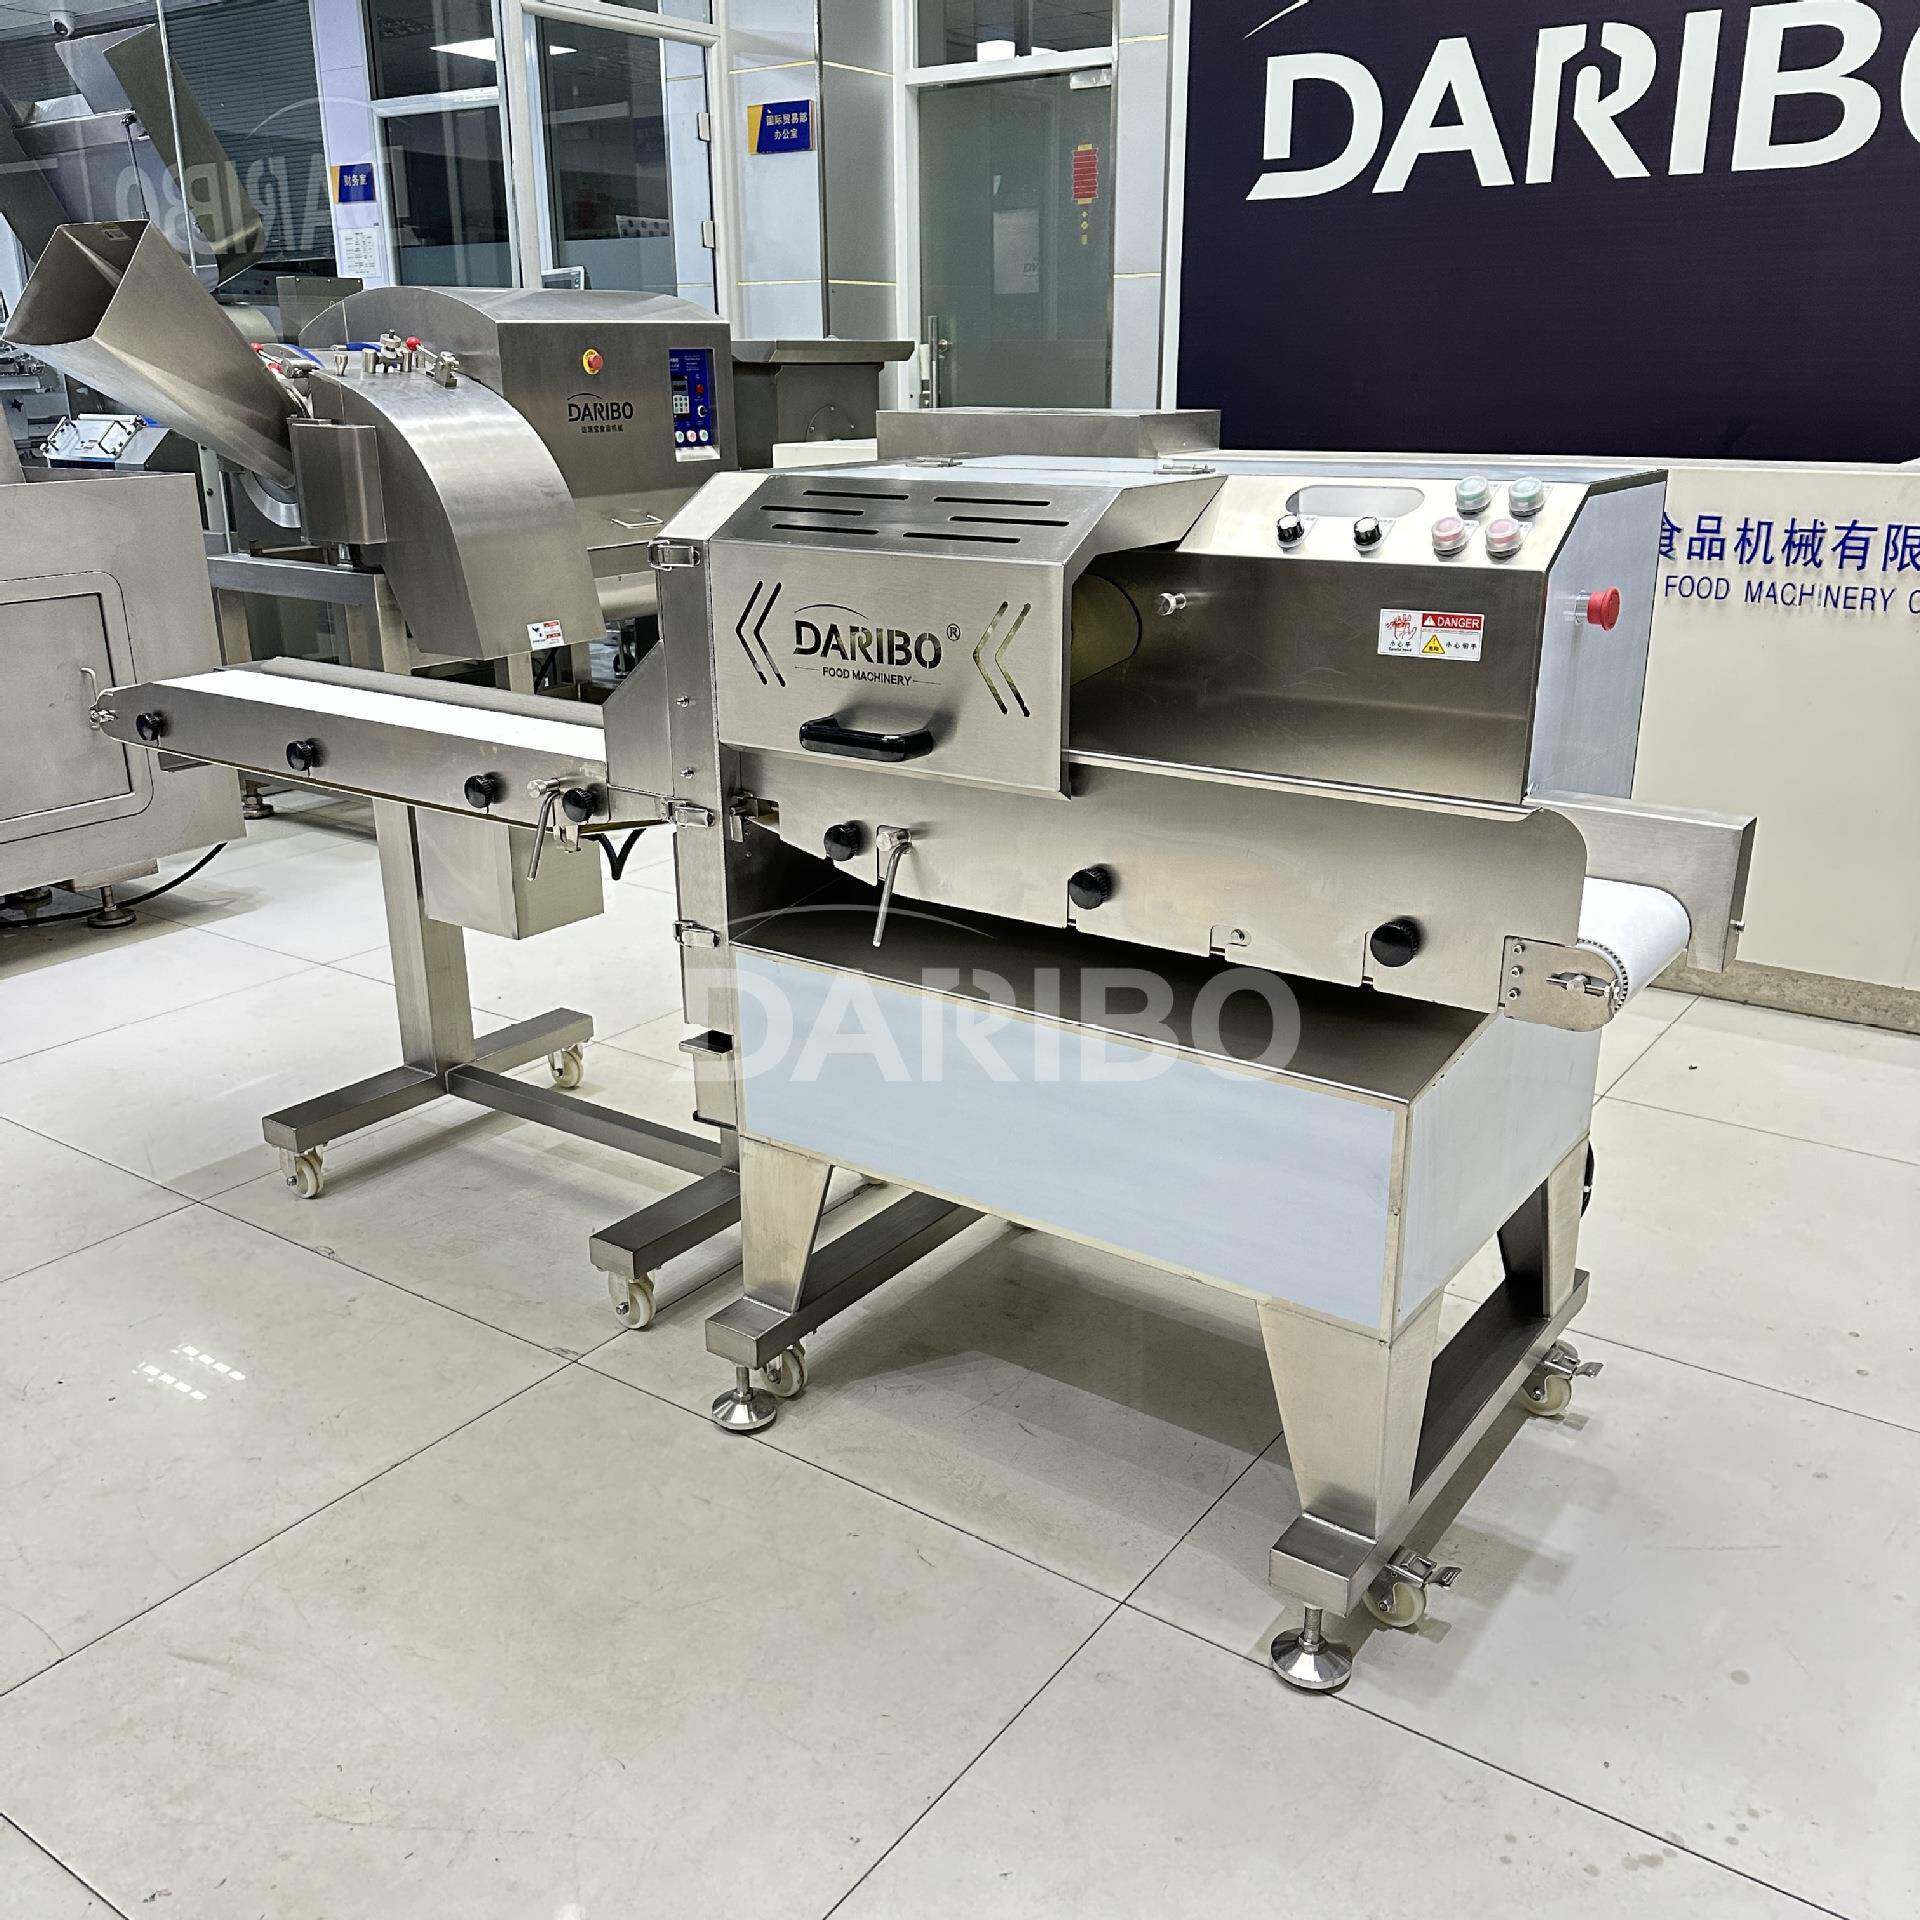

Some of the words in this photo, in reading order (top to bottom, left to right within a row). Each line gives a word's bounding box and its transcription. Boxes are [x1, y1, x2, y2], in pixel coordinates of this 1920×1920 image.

[1245, 0, 1920, 200] DARIB
[766, 112, 807, 126] 国际贸易部
[774, 127, 798, 140] 办公室
[343, 173, 367, 187] 财务室
[567, 401, 634, 422] DARIBO
[1665, 575, 1730, 600] FOOD
[1744, 580, 1896, 612] MACHINERY
[1437, 616, 1480, 629] DANGER
[793, 619, 942, 670] DARIBO
[822, 666, 850, 679] FOOD
[852, 669, 913, 686] MACHINERY
